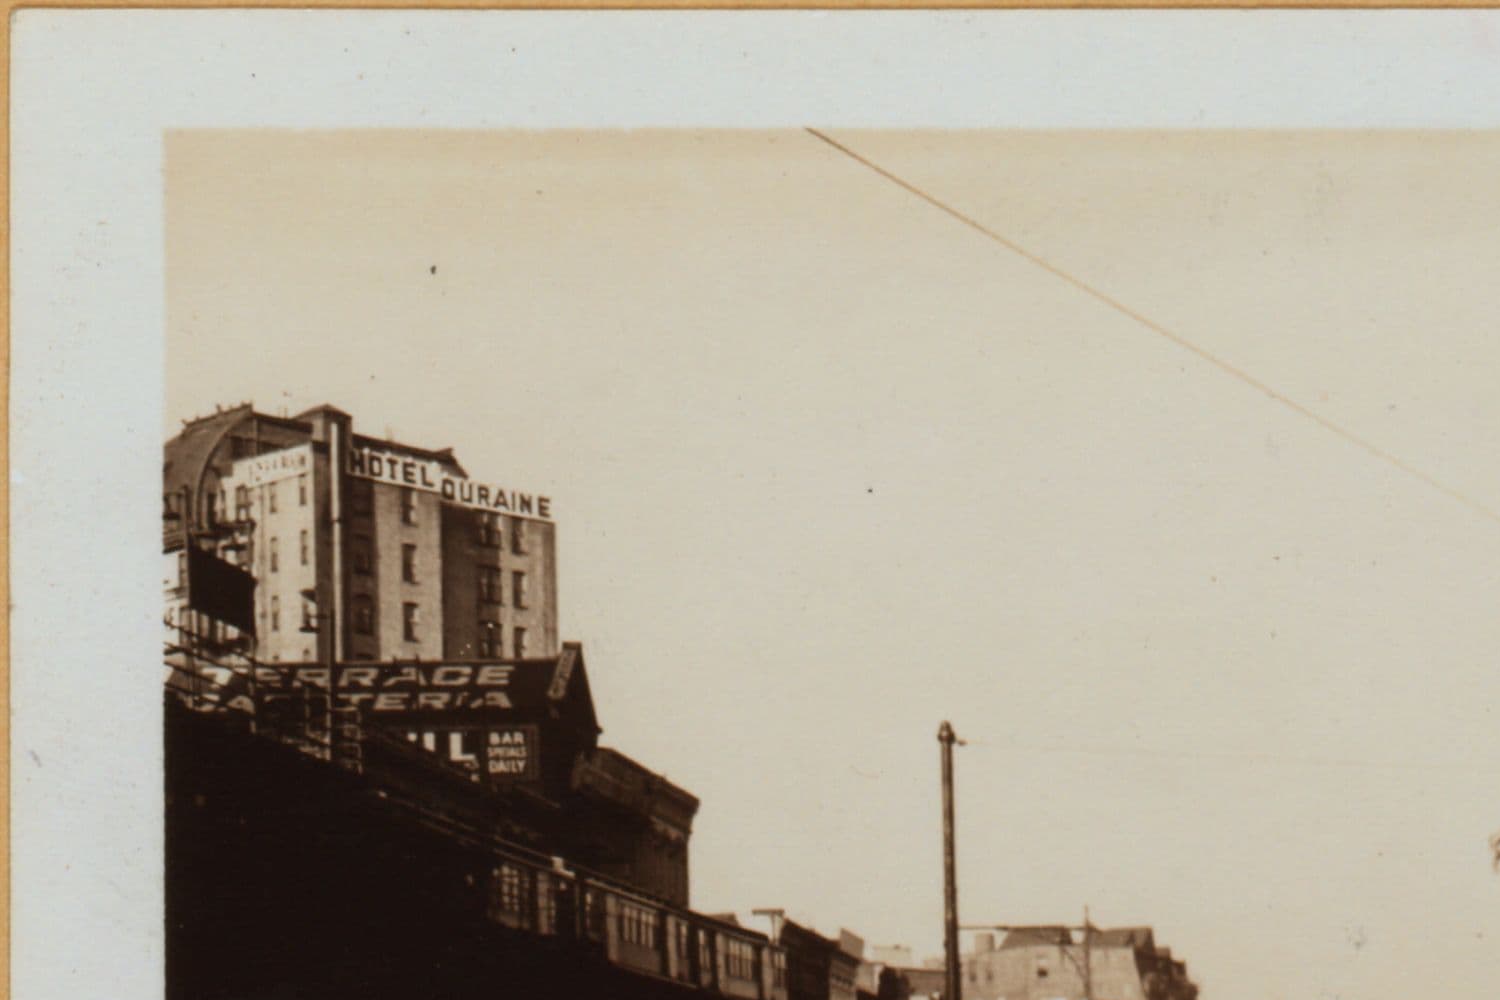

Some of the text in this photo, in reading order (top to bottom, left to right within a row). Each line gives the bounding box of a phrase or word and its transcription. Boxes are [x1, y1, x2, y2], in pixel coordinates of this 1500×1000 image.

[349, 448, 435, 488] HOTEL
[488, 731, 525, 745] BAR
[487, 759, 527, 774] DAILY
